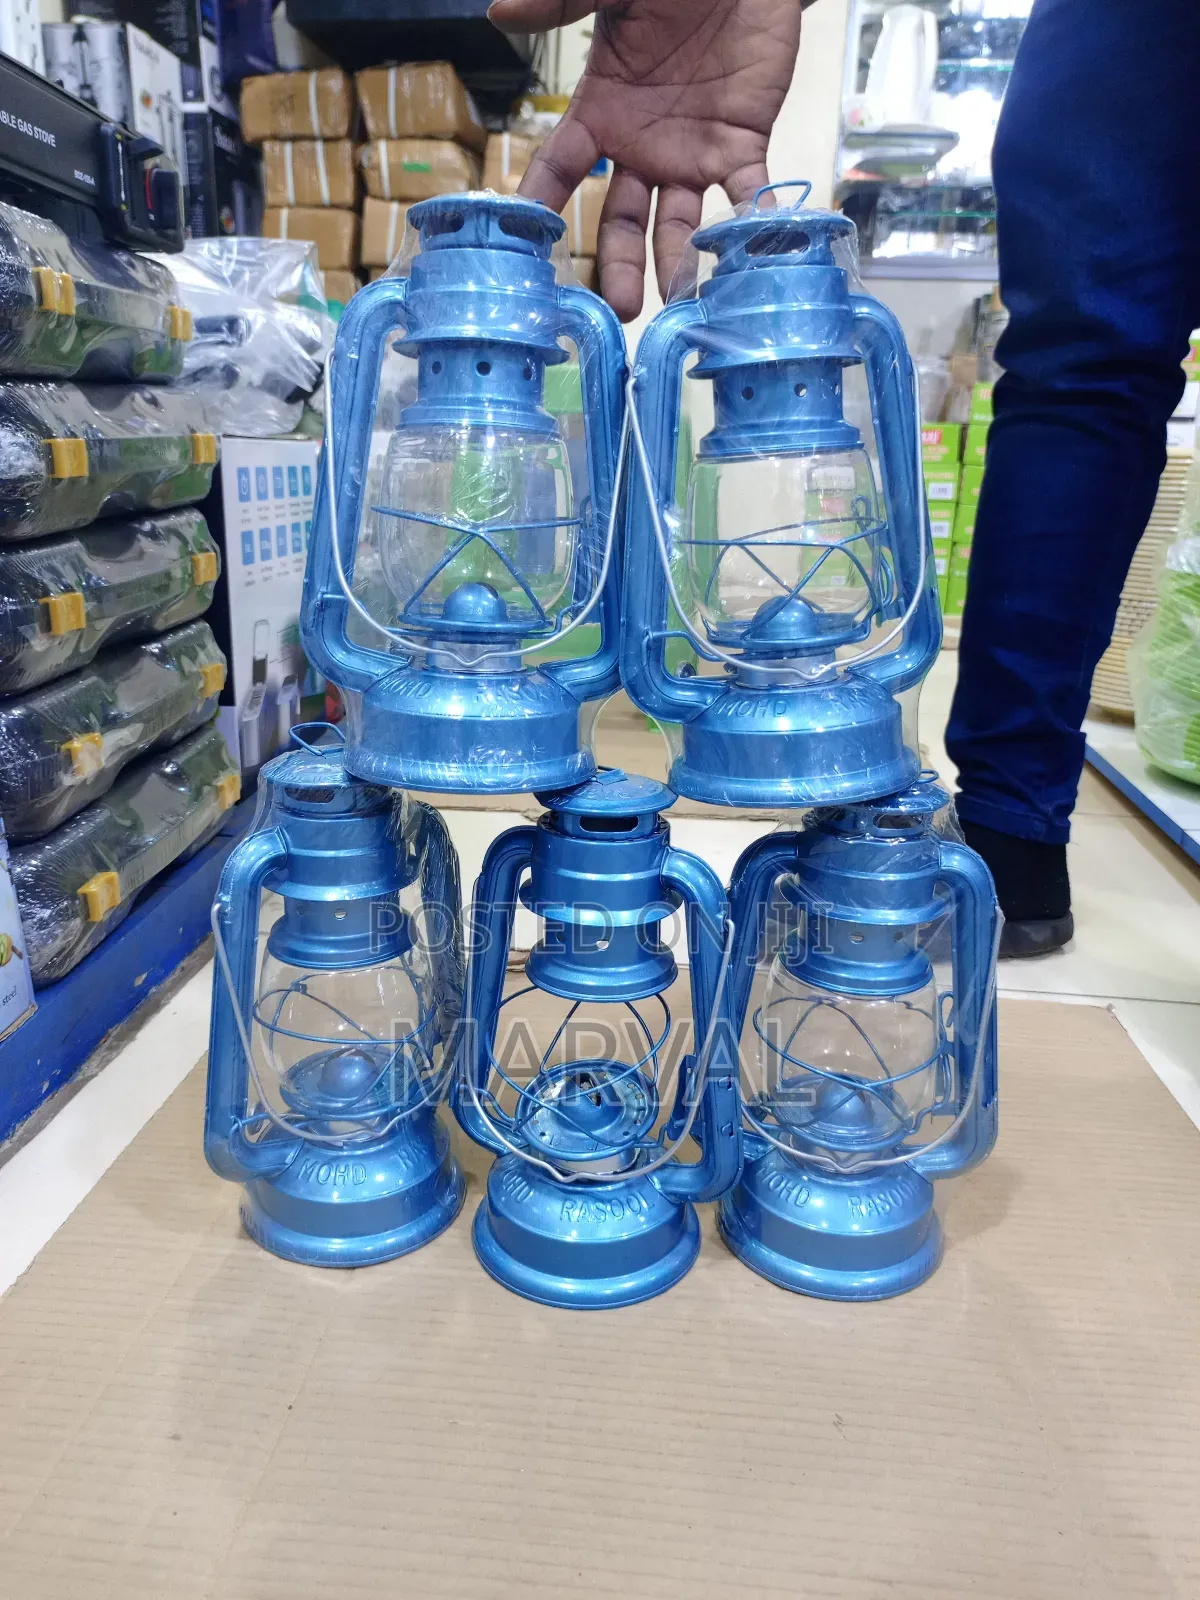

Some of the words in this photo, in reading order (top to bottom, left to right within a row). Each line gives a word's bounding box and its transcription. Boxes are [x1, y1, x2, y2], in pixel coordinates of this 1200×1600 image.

[17, 118, 33, 136] GAS
[33, 126, 56, 148] STOVE
[714, 699, 787, 718] MOHD
[2, 985, 17, 1006] steel
[297, 1158, 367, 1187] MOHD
[757, 1161, 812, 1208] MOHD
[559, 1192, 656, 1224] RASOOL
